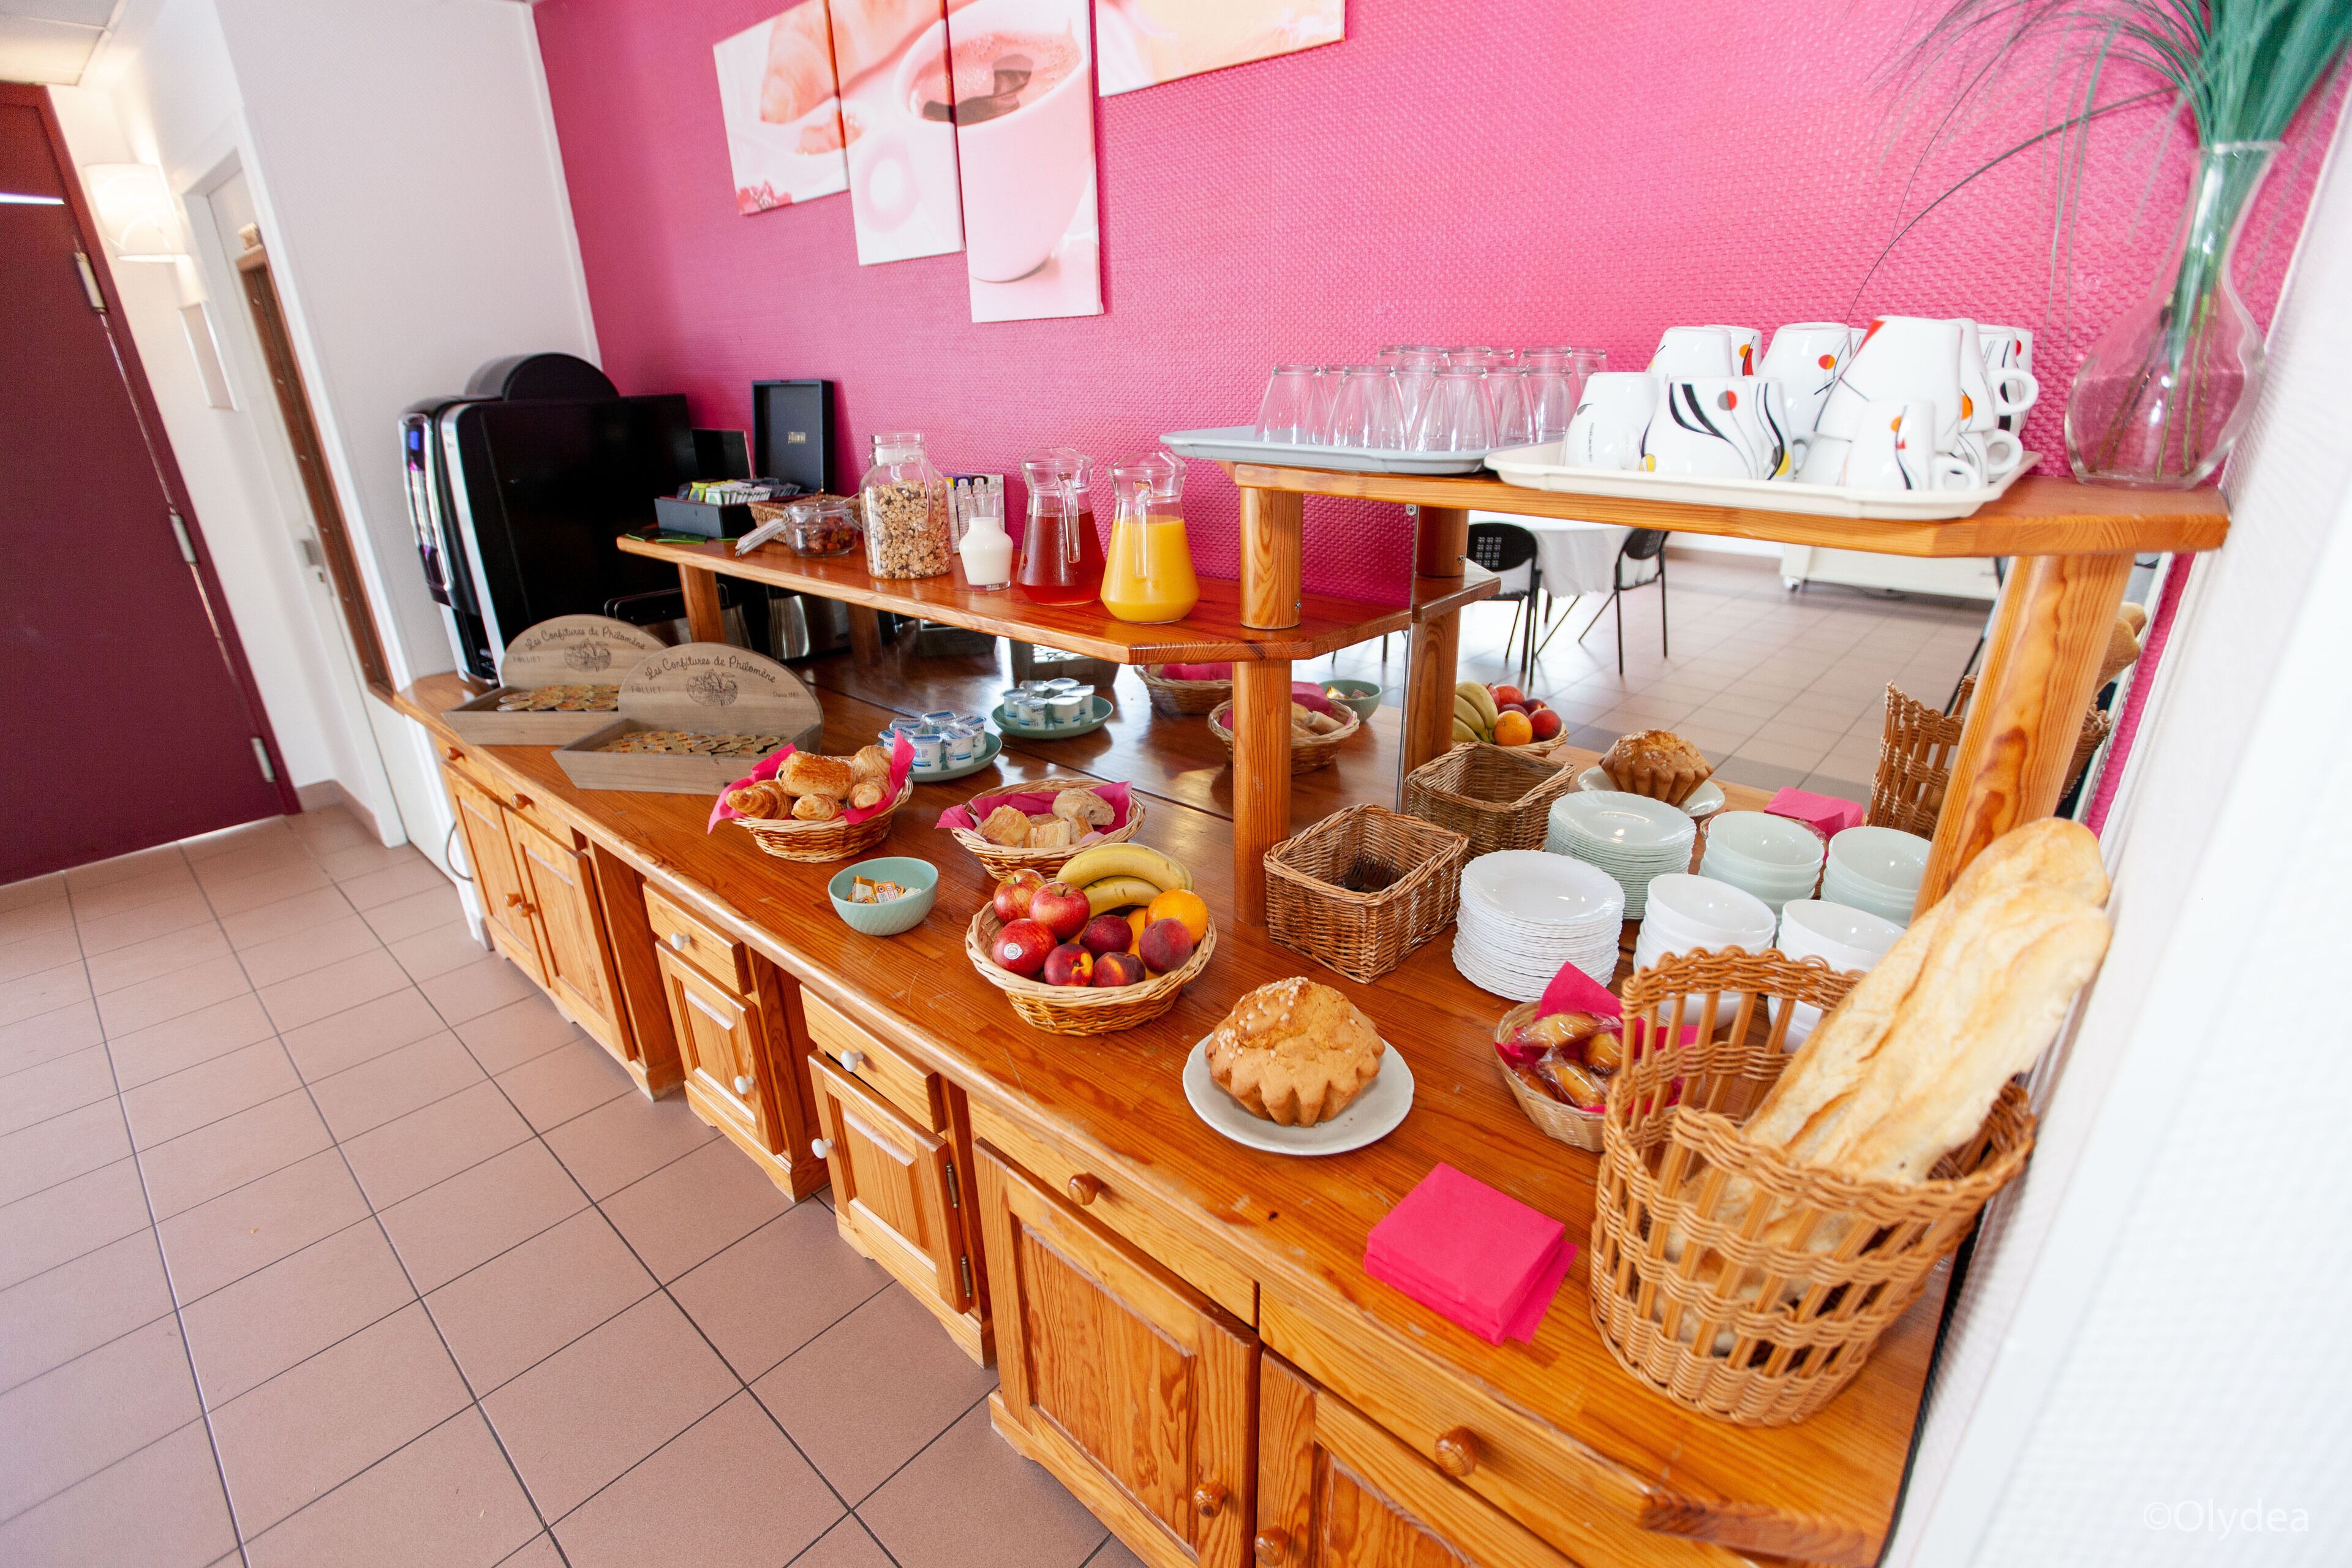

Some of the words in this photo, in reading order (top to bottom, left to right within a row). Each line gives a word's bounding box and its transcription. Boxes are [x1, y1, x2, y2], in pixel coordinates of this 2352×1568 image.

[525, 638, 541, 650] Les
[541, 627, 585, 641] Confitures
[589, 627, 599, 635] de
[602, 626, 645, 650] Philomène
[644, 666, 662, 680] Les
[662, 656, 710, 671] Confitures
[714, 656, 725, 666] de
[729, 655, 775, 683] Philomène
[631, 685, 661, 693] FOLLIET
